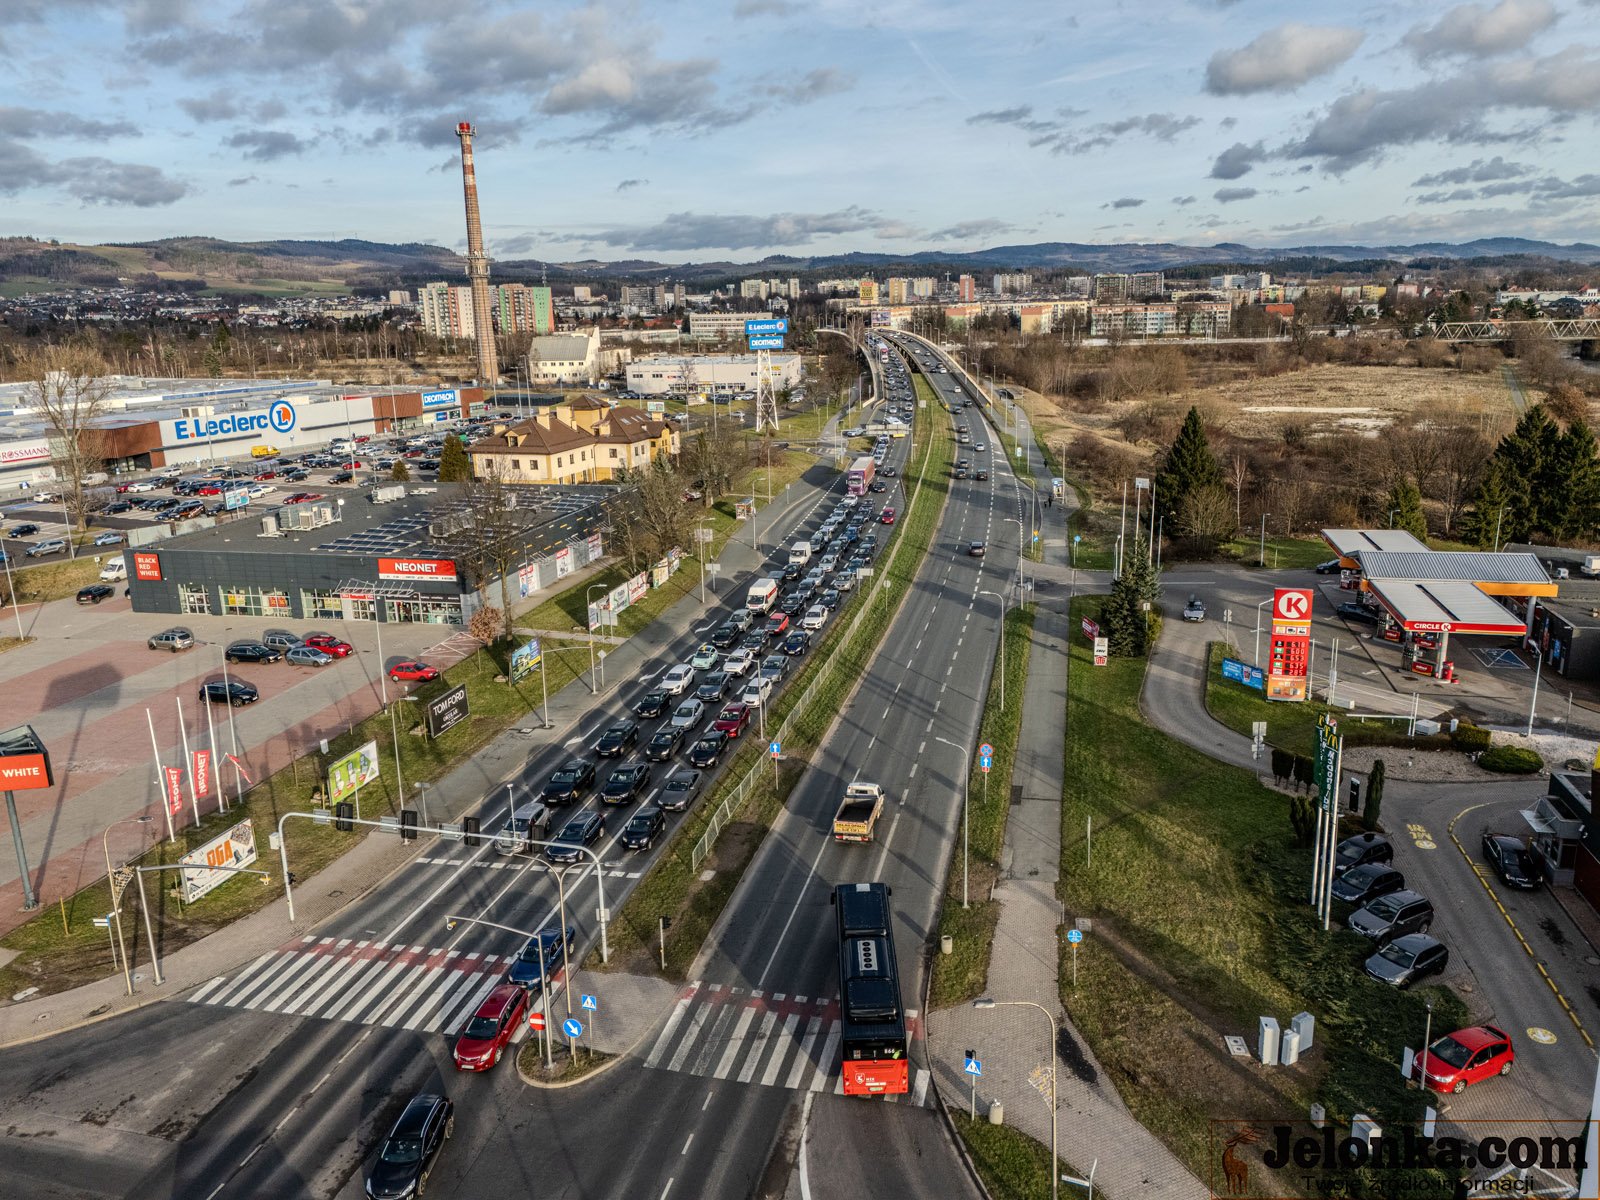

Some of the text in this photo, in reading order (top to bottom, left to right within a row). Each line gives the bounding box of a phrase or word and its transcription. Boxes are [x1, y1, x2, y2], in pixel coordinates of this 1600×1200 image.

[424, 392, 454, 403] DECATHLON
[175, 414, 268, 439] E.Leclerc
[2, 447, 50, 460] ROSSMANN
[394, 562, 437, 573] NEONET
[433, 690, 464, 715] TOM FORD
[2, 767, 40, 778] WHITE
[197, 753, 207, 794] NEONET
